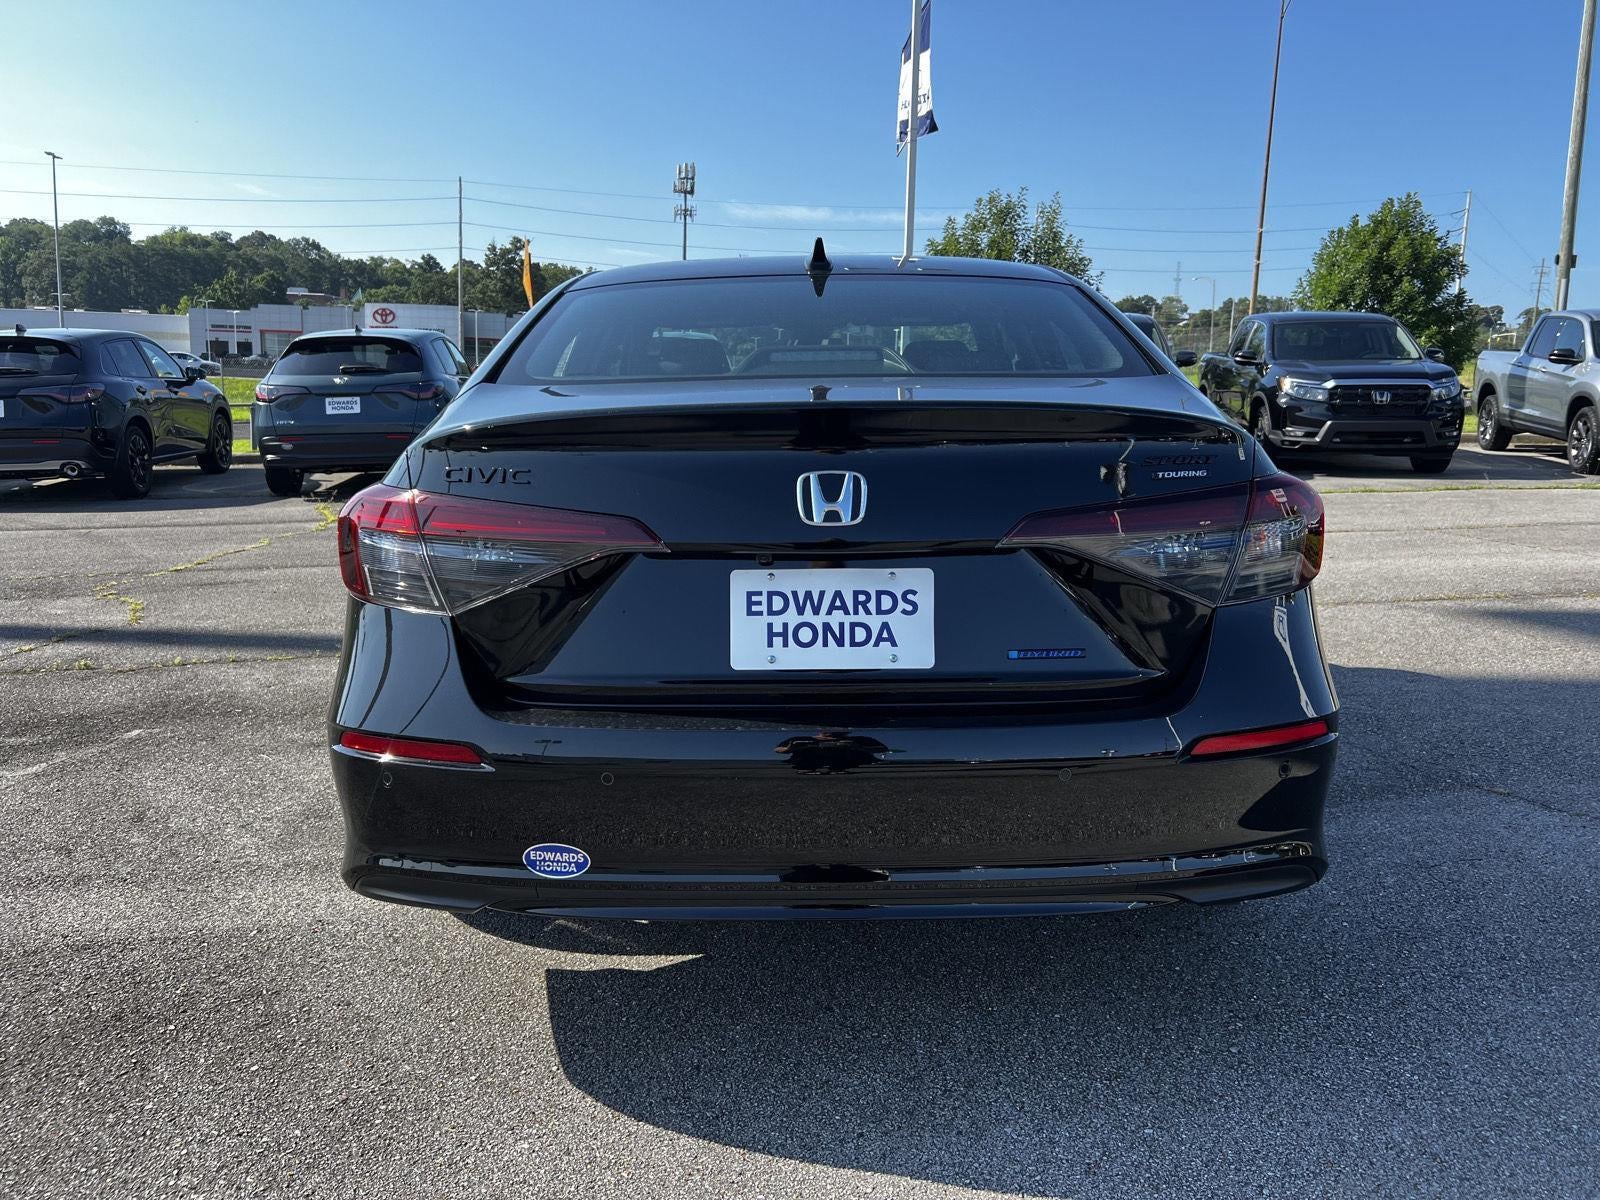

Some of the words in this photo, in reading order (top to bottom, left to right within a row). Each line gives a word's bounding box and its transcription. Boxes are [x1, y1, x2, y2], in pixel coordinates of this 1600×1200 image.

[445, 466, 531, 484] CIVIC
[1156, 470, 1207, 479] TOURING
[746, 589, 919, 617] EDWARDS
[767, 621, 899, 649] HONDA
[530, 851, 584, 862] EDWARDS
[536, 861, 577, 872] HONDA
